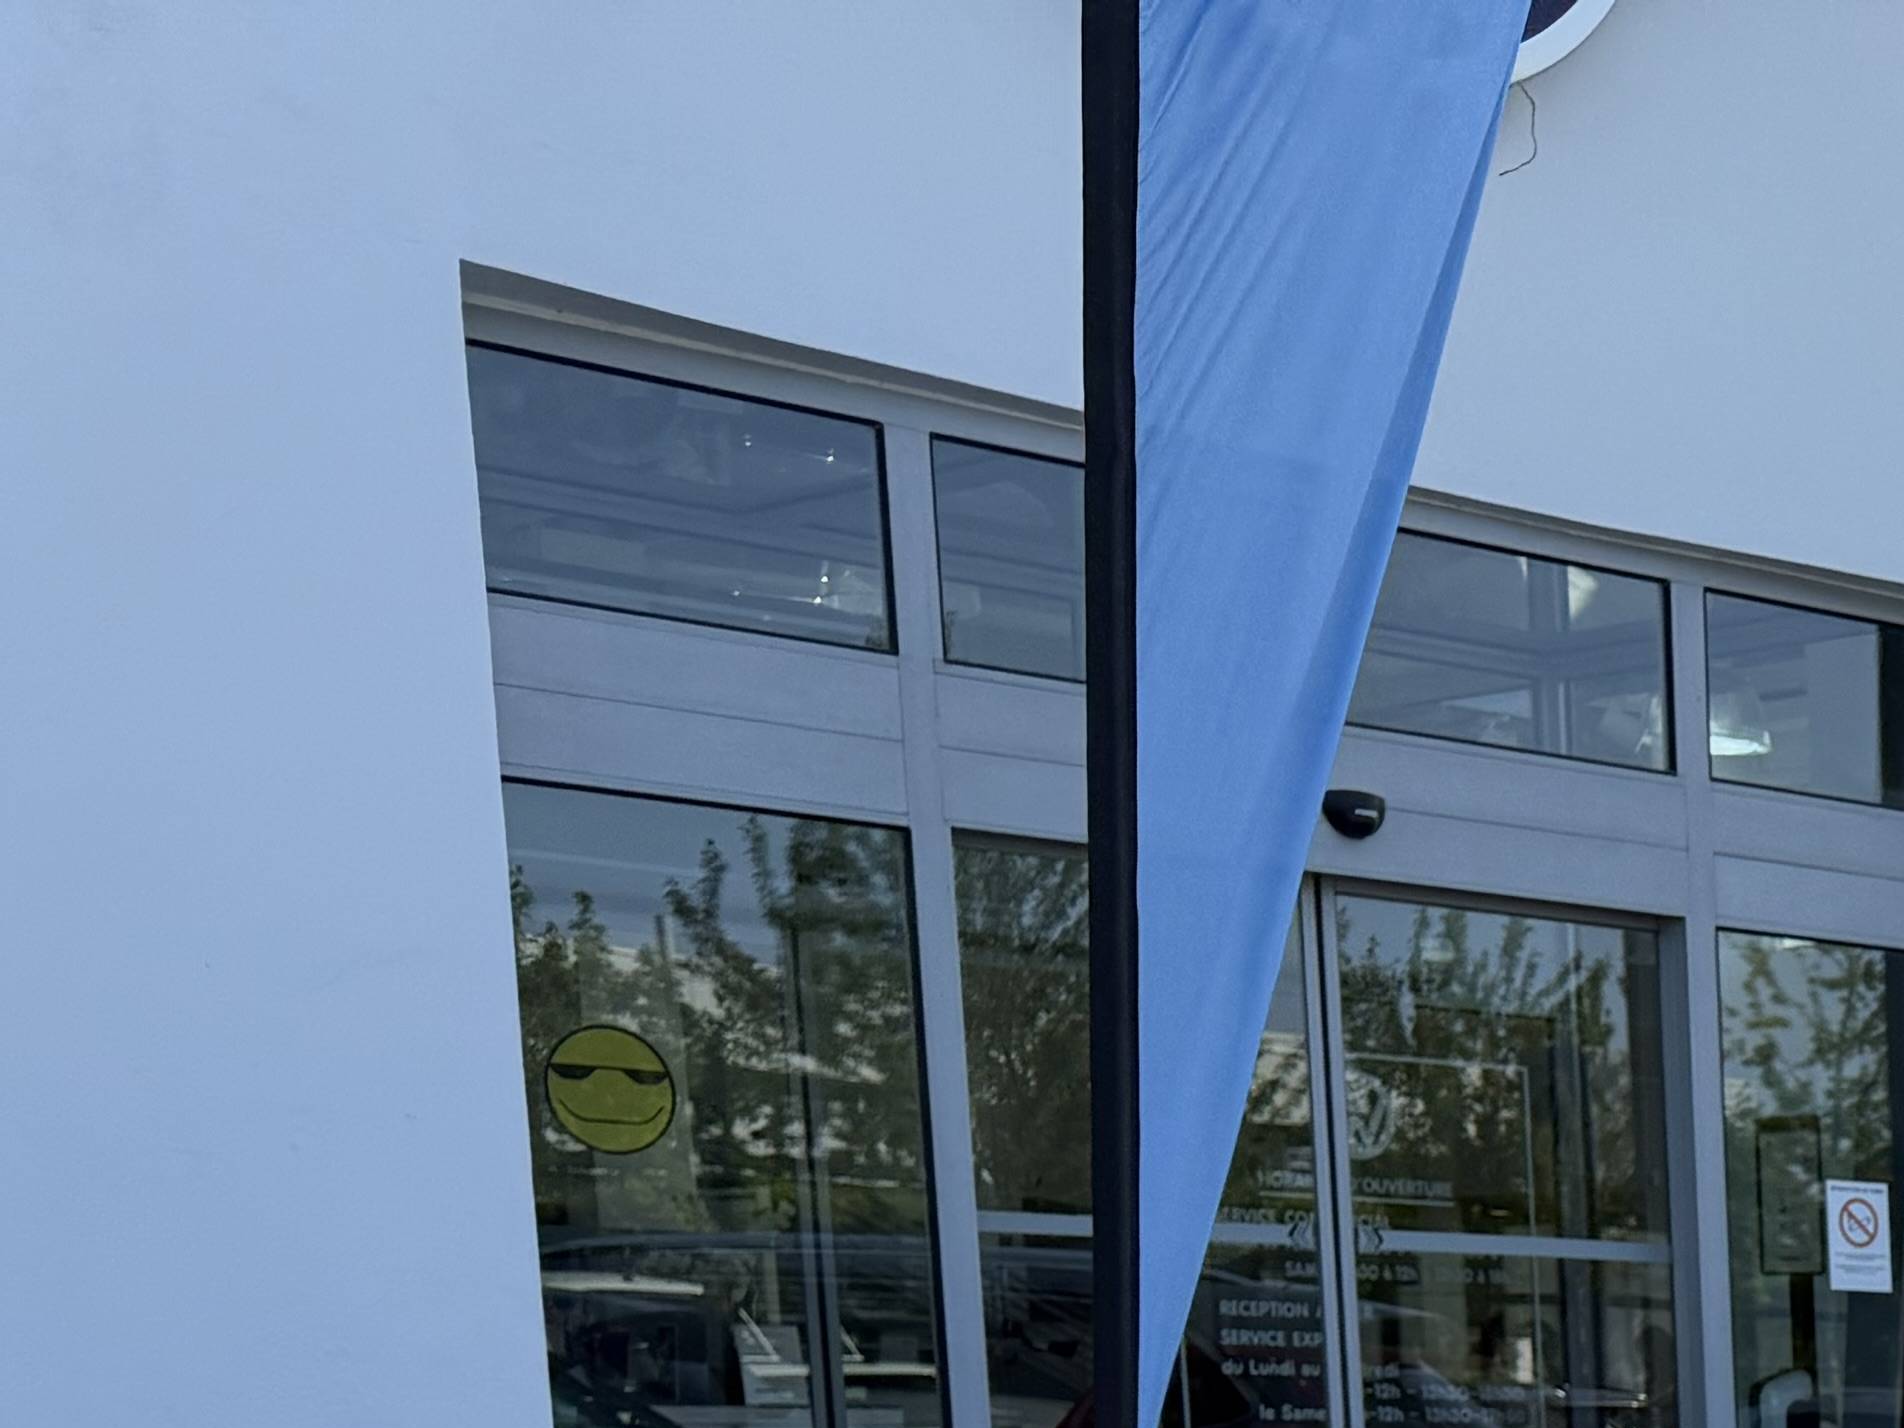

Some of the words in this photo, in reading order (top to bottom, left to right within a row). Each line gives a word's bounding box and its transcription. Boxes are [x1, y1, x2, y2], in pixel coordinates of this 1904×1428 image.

[1220, 1329, 1285, 1347] SERVICE
[1221, 1358, 1244, 1376] du
[1250, 1358, 1296, 1377] Lundi
